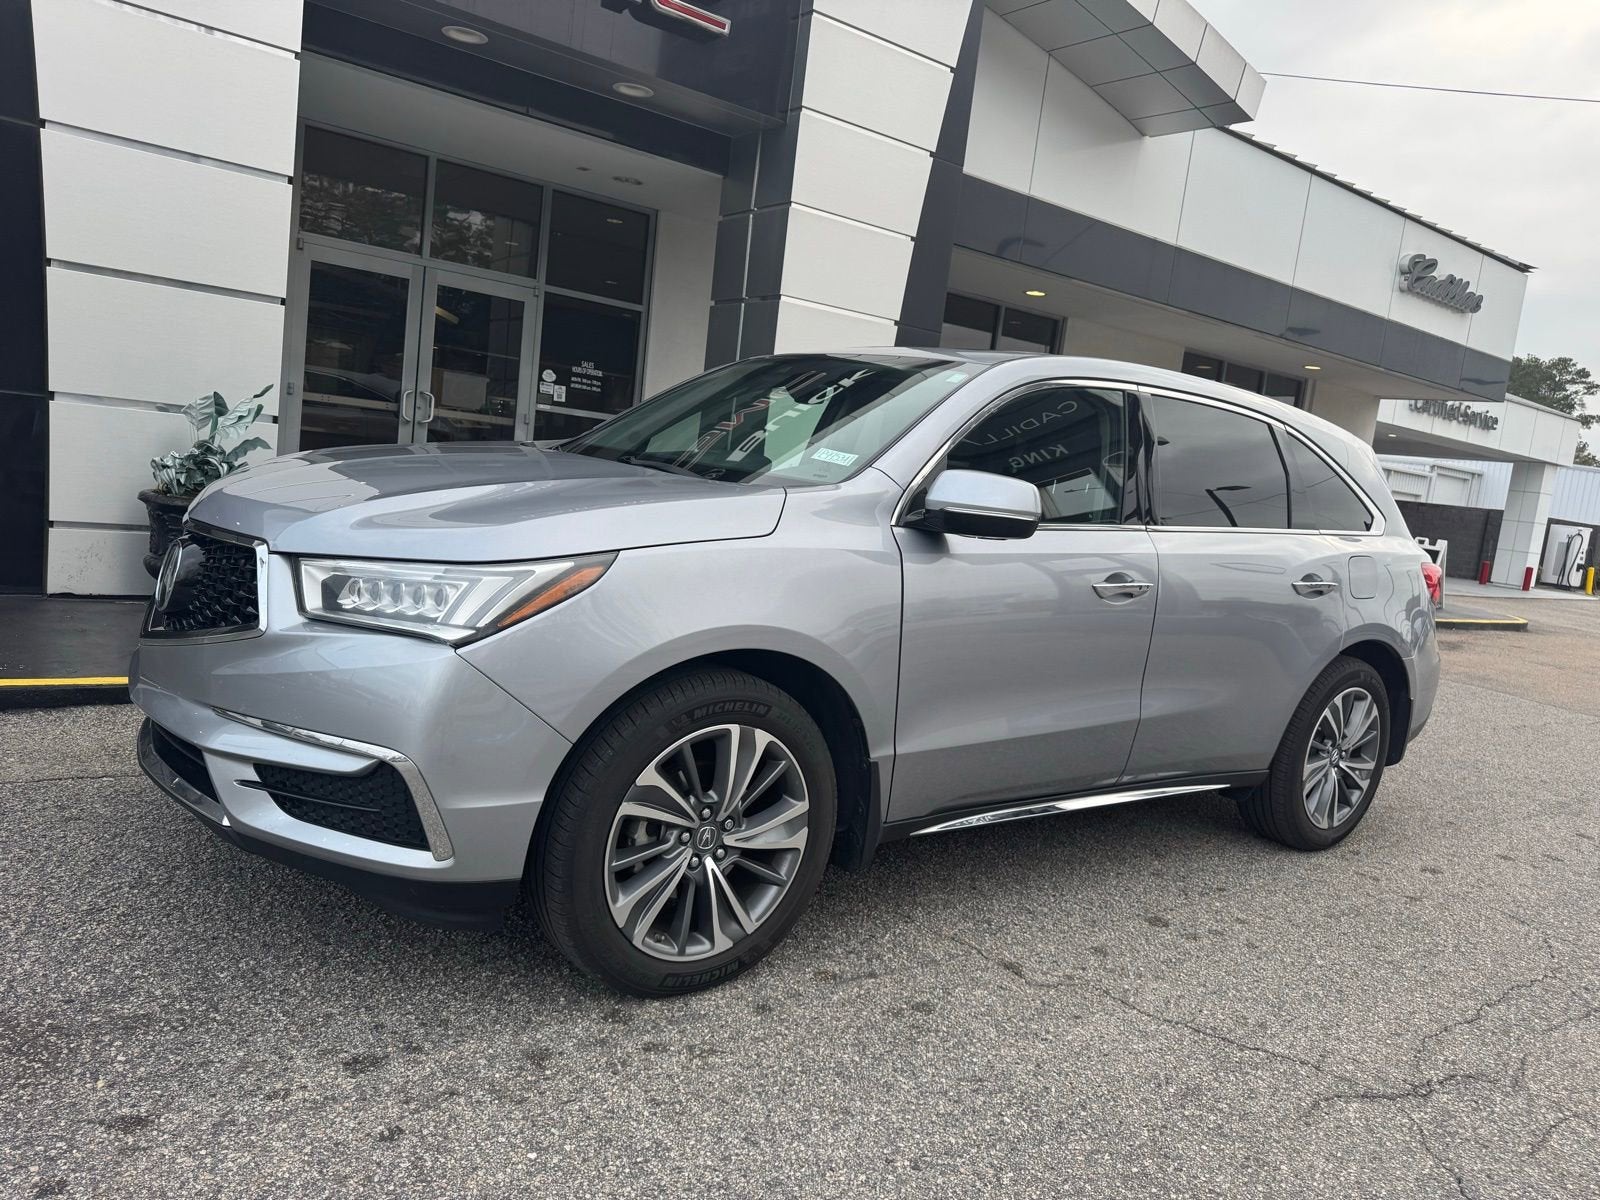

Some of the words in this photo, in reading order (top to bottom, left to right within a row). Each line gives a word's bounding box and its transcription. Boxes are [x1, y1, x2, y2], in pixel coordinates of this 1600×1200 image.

[581, 361, 594, 369] SALES
[1462, 405, 1498, 430] Service
[694, 702, 768, 719] MICHELIN
[664, 960, 739, 986] MICHELIN
